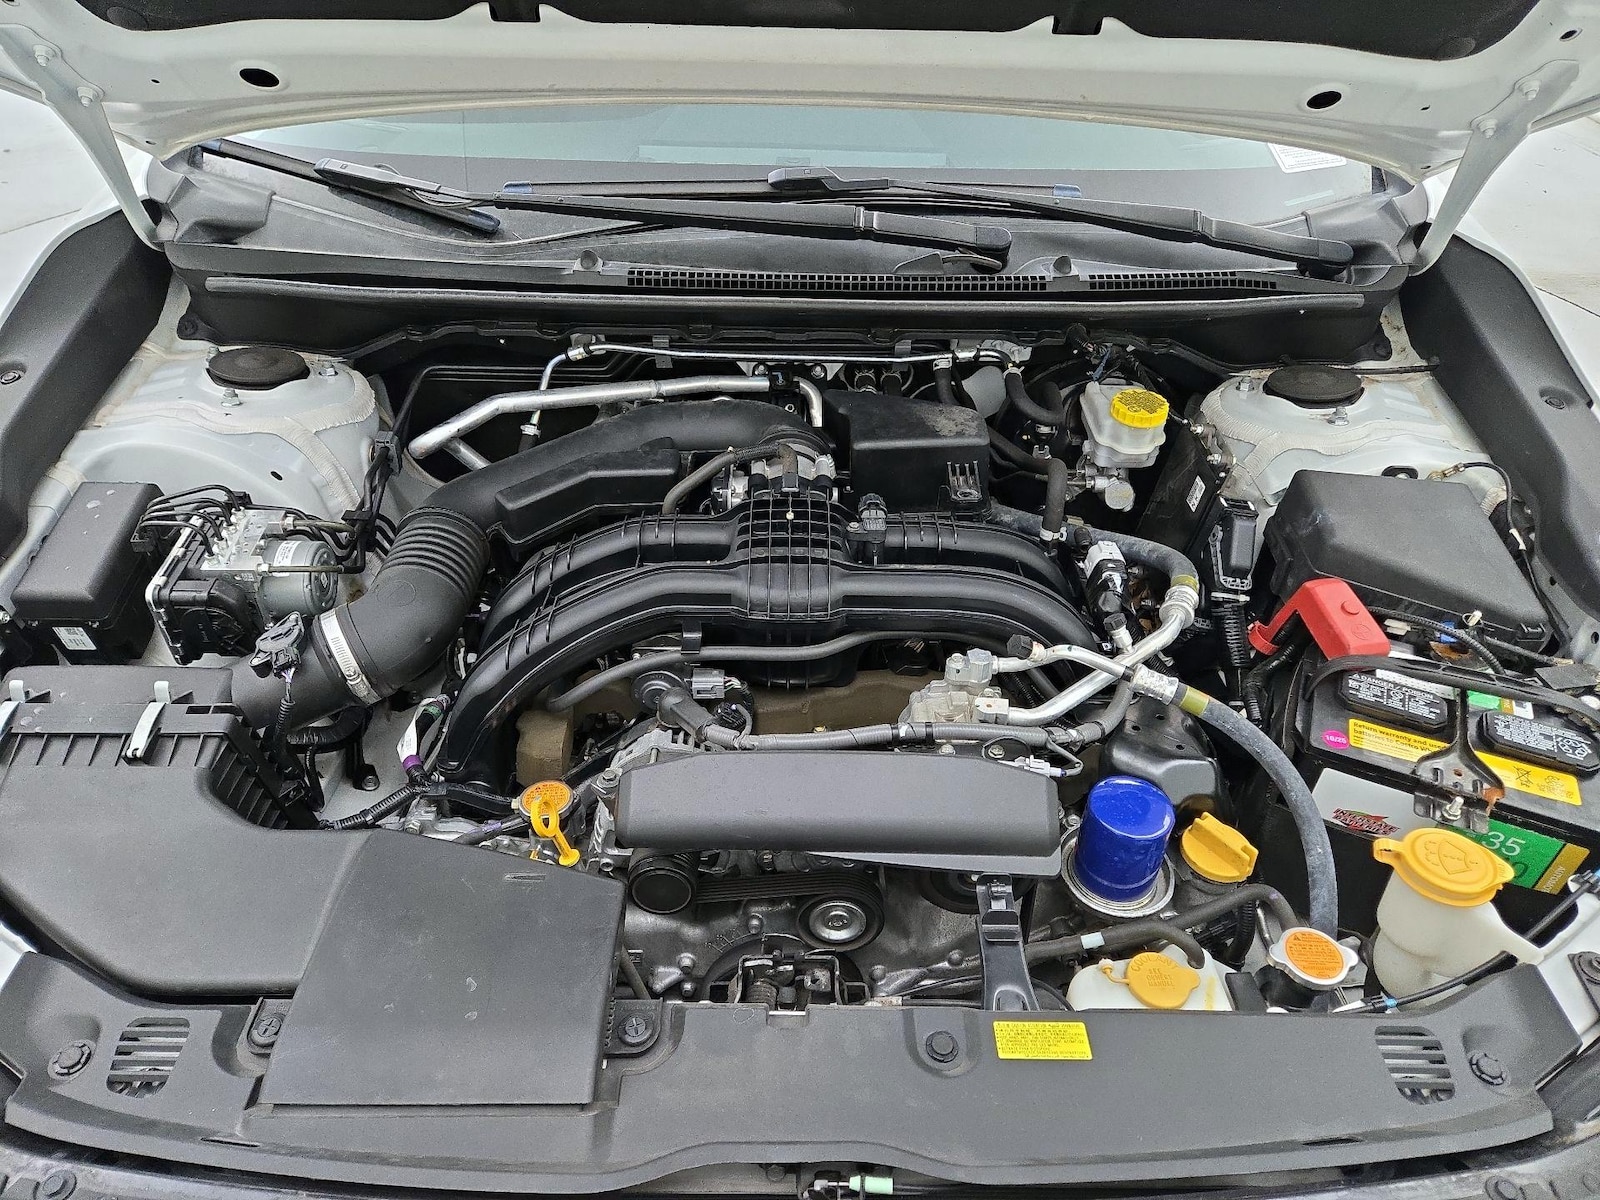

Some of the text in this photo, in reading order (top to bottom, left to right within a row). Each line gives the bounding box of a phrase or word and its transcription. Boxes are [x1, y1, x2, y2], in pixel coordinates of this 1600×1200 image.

[1360, 676, 1394, 690] DANGER
[1402, 687, 1434, 700] POISON
[1354, 722, 1378, 733] Return
[1379, 729, 1411, 743] warranty
[1413, 737, 1427, 746] and
[1354, 728, 1386, 742] batteries
[1395, 739, 1419, 751] Costco
[1332, 814, 1391, 836] BATTERIES
[1333, 807, 1400, 833] INTERSTATE
[1481, 831, 1526, 856] 35
[1130, 953, 1180, 973] COOLANT
[1149, 967, 1161, 975] SEE
[1147, 980, 1176, 988] MANUAL
